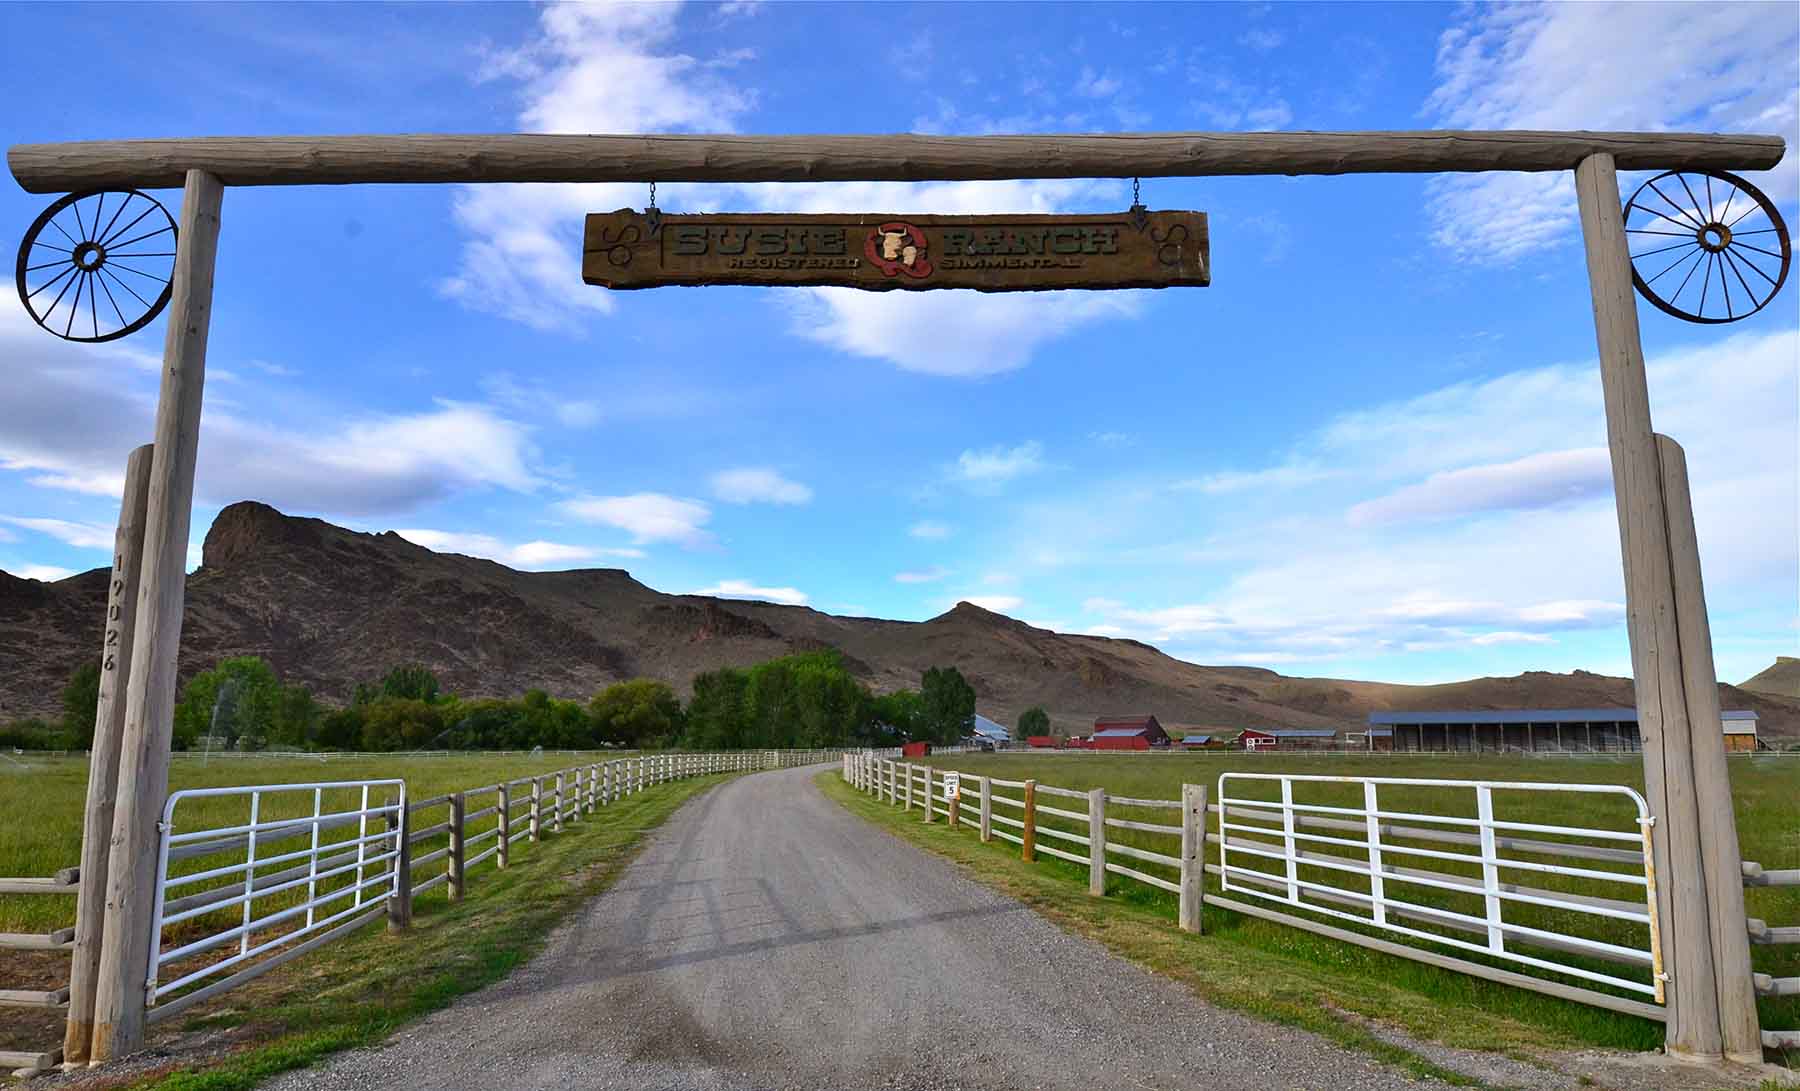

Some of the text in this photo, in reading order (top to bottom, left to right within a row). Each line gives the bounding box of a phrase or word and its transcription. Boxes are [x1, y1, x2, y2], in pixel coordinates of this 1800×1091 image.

[672, 225, 847, 255] SUSIE
[942, 225, 1120, 255] RANCH
[729, 257, 1083, 270] REGISTERED SIMMENTAL
[949, 786, 954, 794] 5
